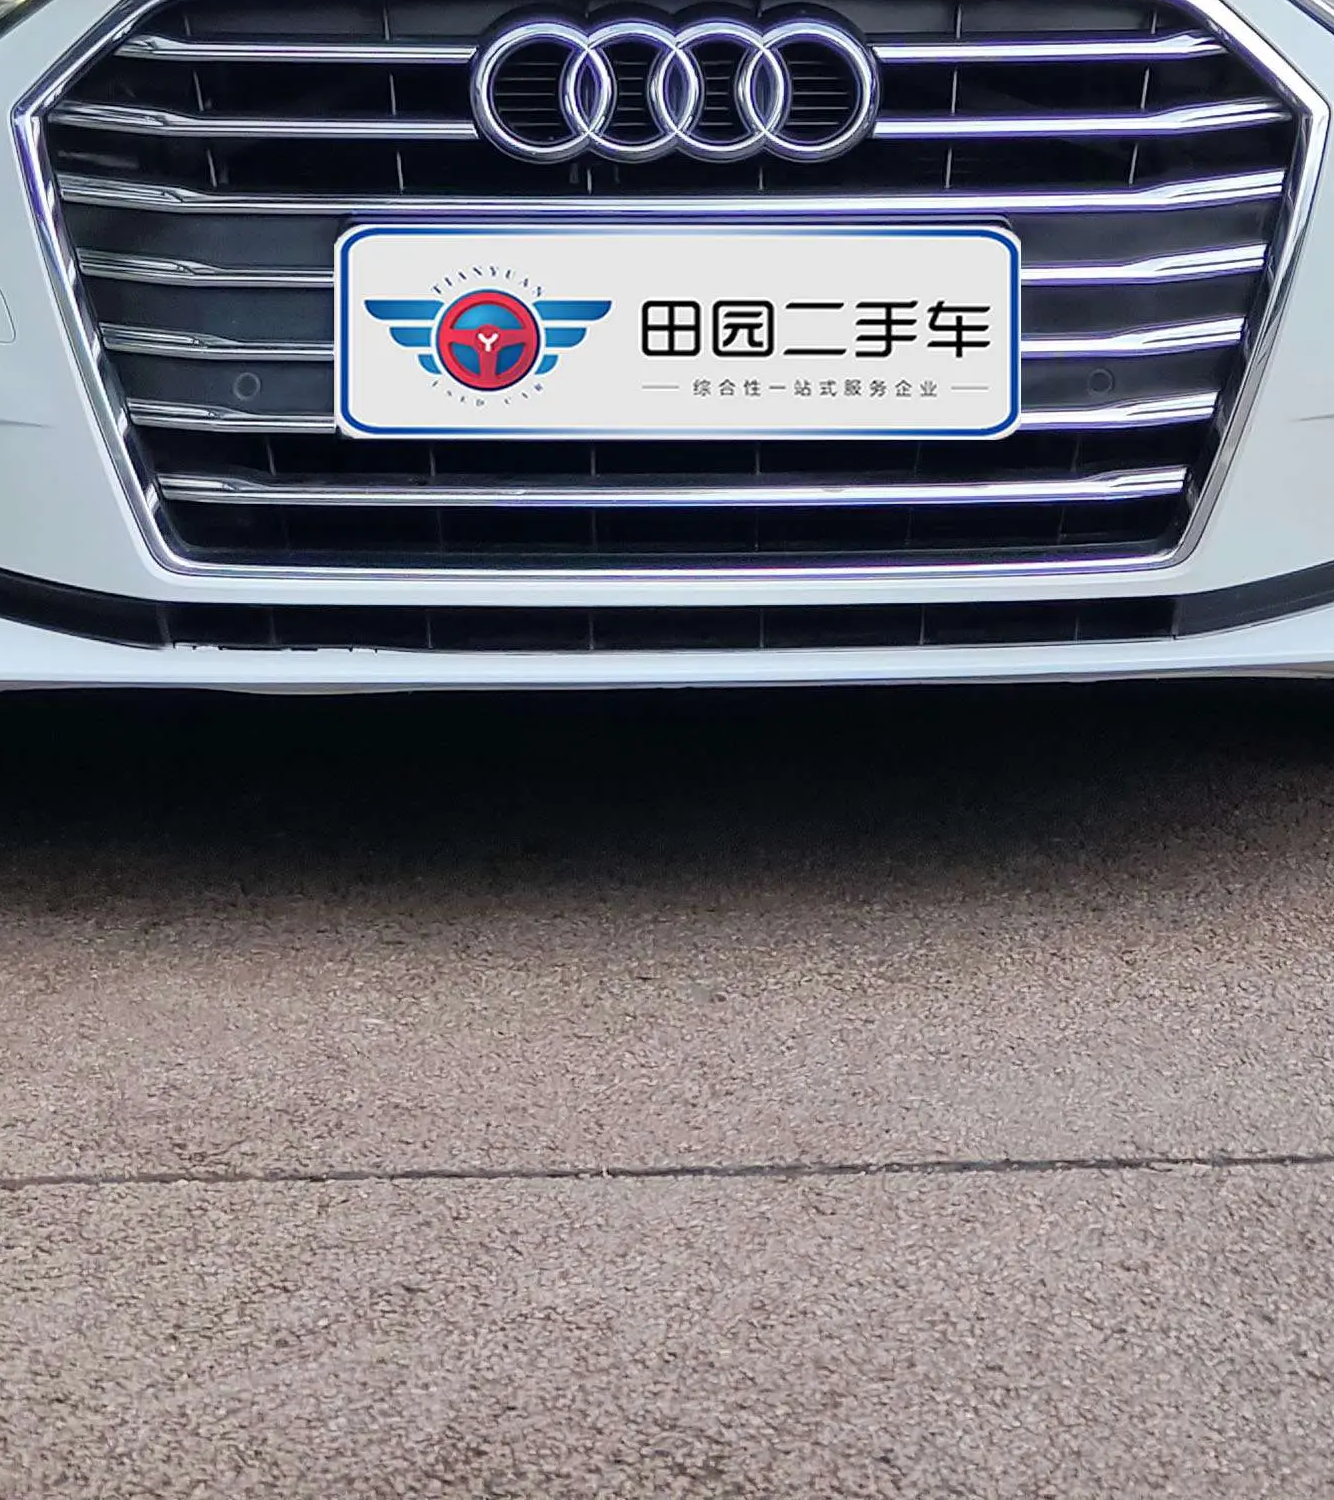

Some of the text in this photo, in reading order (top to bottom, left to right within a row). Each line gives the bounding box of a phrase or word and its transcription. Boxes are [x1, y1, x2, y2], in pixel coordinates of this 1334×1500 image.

[642, 300, 991, 358] 田园二手车
[692, 380, 938, 398] 综合性一站式服务企业
